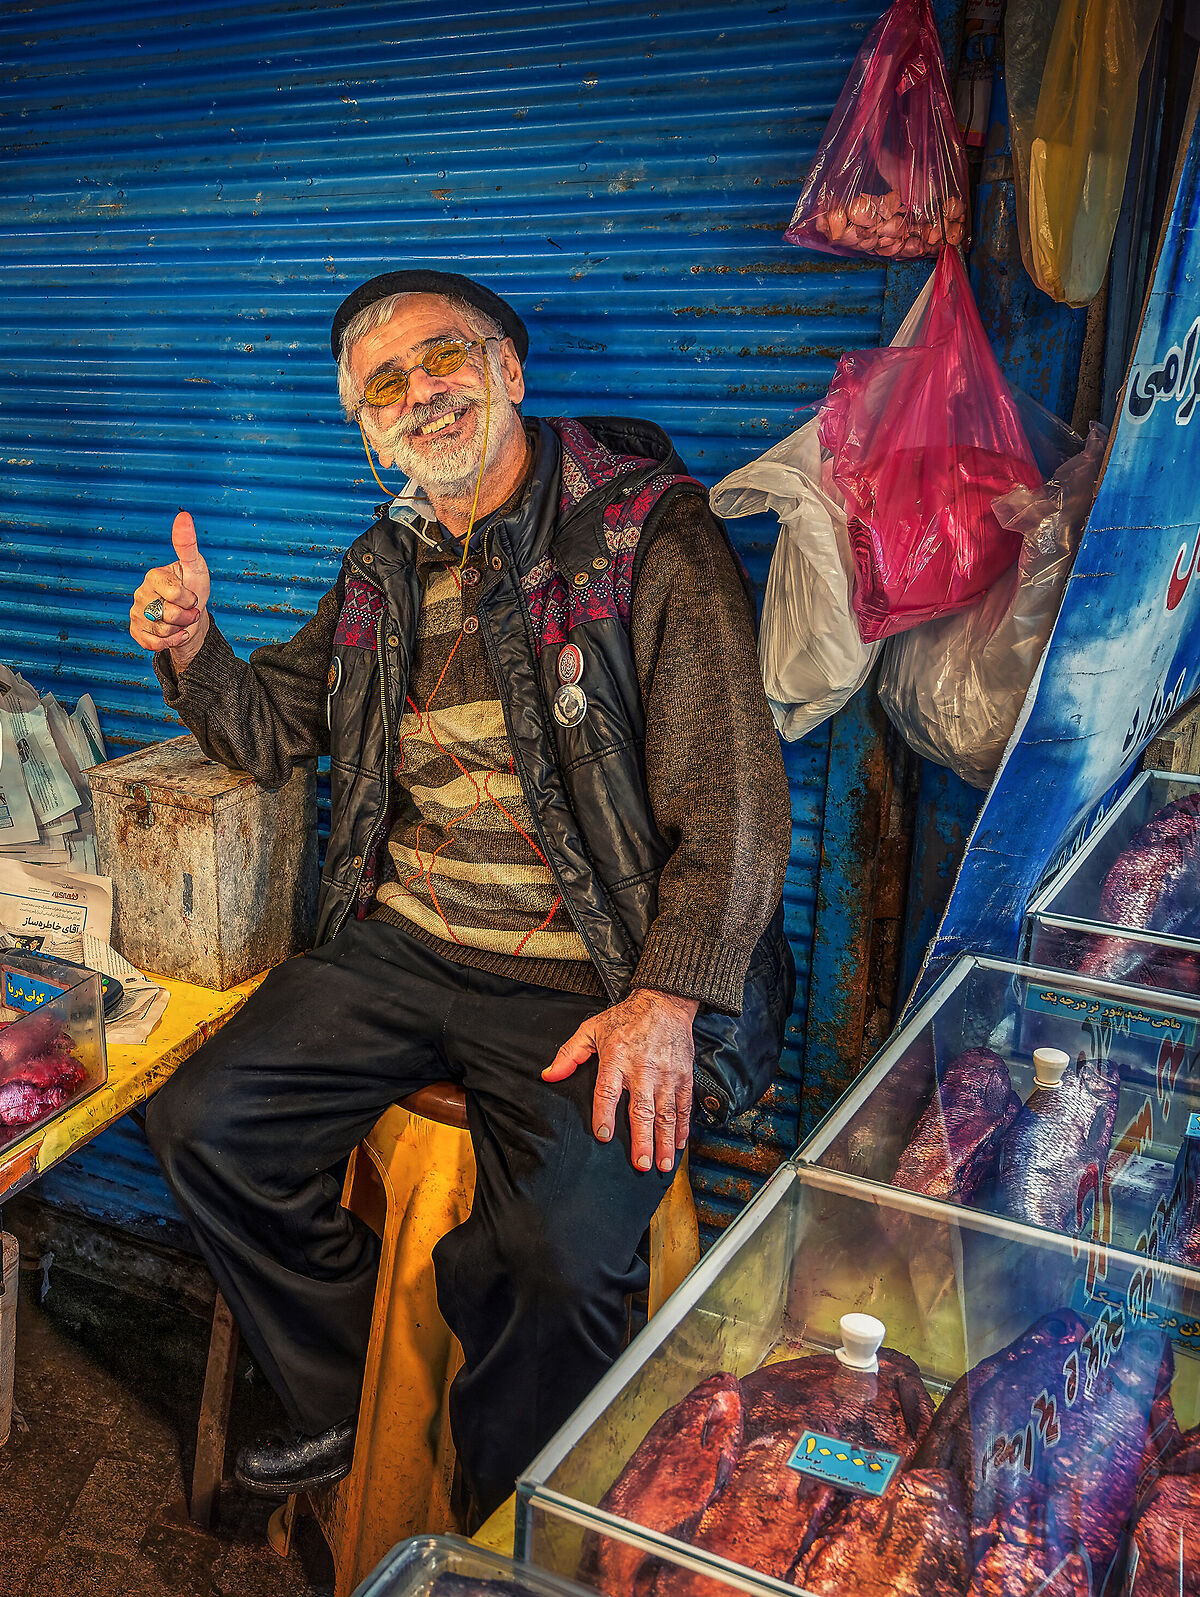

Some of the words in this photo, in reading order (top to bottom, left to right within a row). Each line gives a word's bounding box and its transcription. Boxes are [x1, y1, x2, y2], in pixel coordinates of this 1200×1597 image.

[62, 923, 80, 934] آقای
[7, 982, 24, 998] دریا
[24, 990, 45, 1005] کولی
[1040, 992, 1058, 1005] یک
[1059, 997, 1088, 1011] درجه
[1102, 1006, 1124, 1017] شور
[1125, 1011, 1150, 1023] سفید
[1151, 1017, 1181, 1030] ماهی
